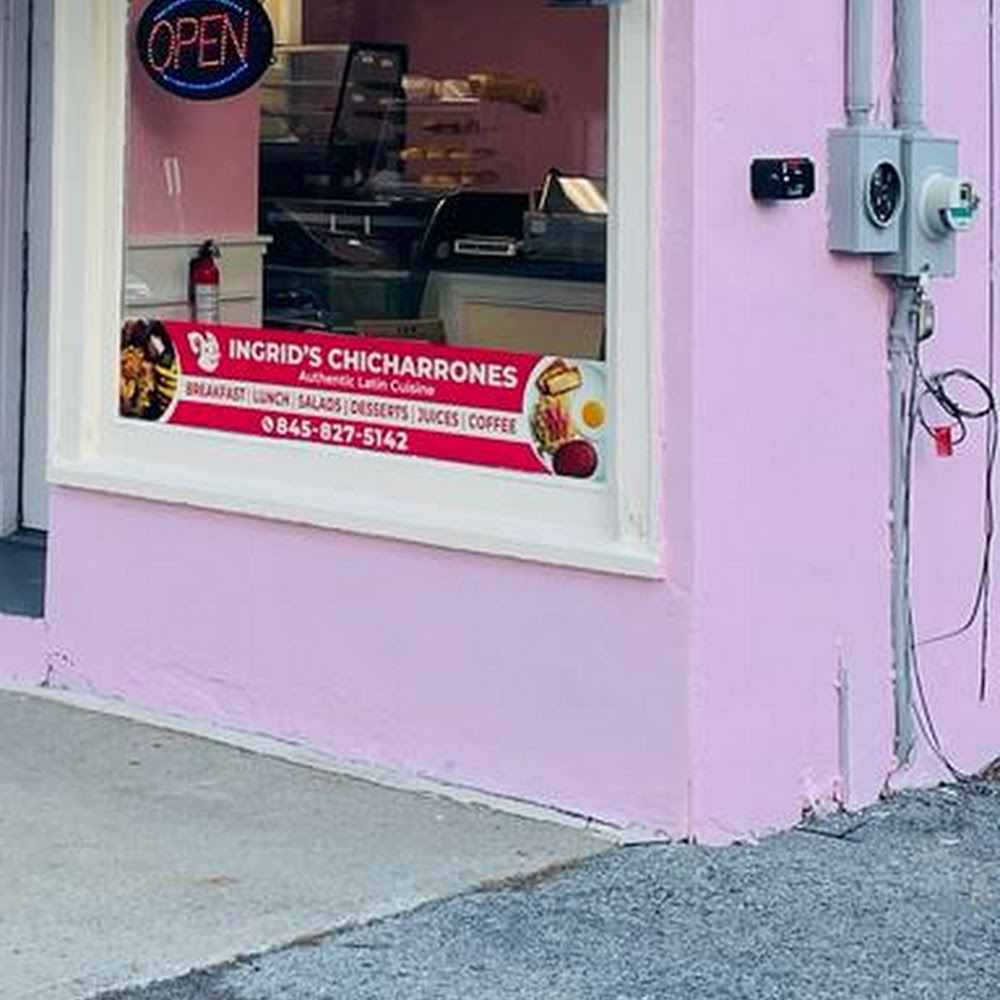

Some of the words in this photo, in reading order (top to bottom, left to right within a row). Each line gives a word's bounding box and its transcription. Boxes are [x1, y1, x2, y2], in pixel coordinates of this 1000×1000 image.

[148, 10, 249, 72] OPEN
[229, 339, 322, 367] INGRID'S
[328, 347, 518, 388] CHICHARRONES
[298, 370, 354, 387] Authentic
[357, 376, 388, 391] Latin
[390, 380, 435, 396] Cuisine
[186, 381, 246, 402] BREAKFAST
[252, 388, 291, 407] LUNCH
[298, 394, 342, 414] SALADS
[350, 400, 409, 421] DESSERTS
[417, 407, 459, 428] JUICES
[468, 413, 518, 434] COFFEE
[276, 416, 409, 450] 845-827-5142
